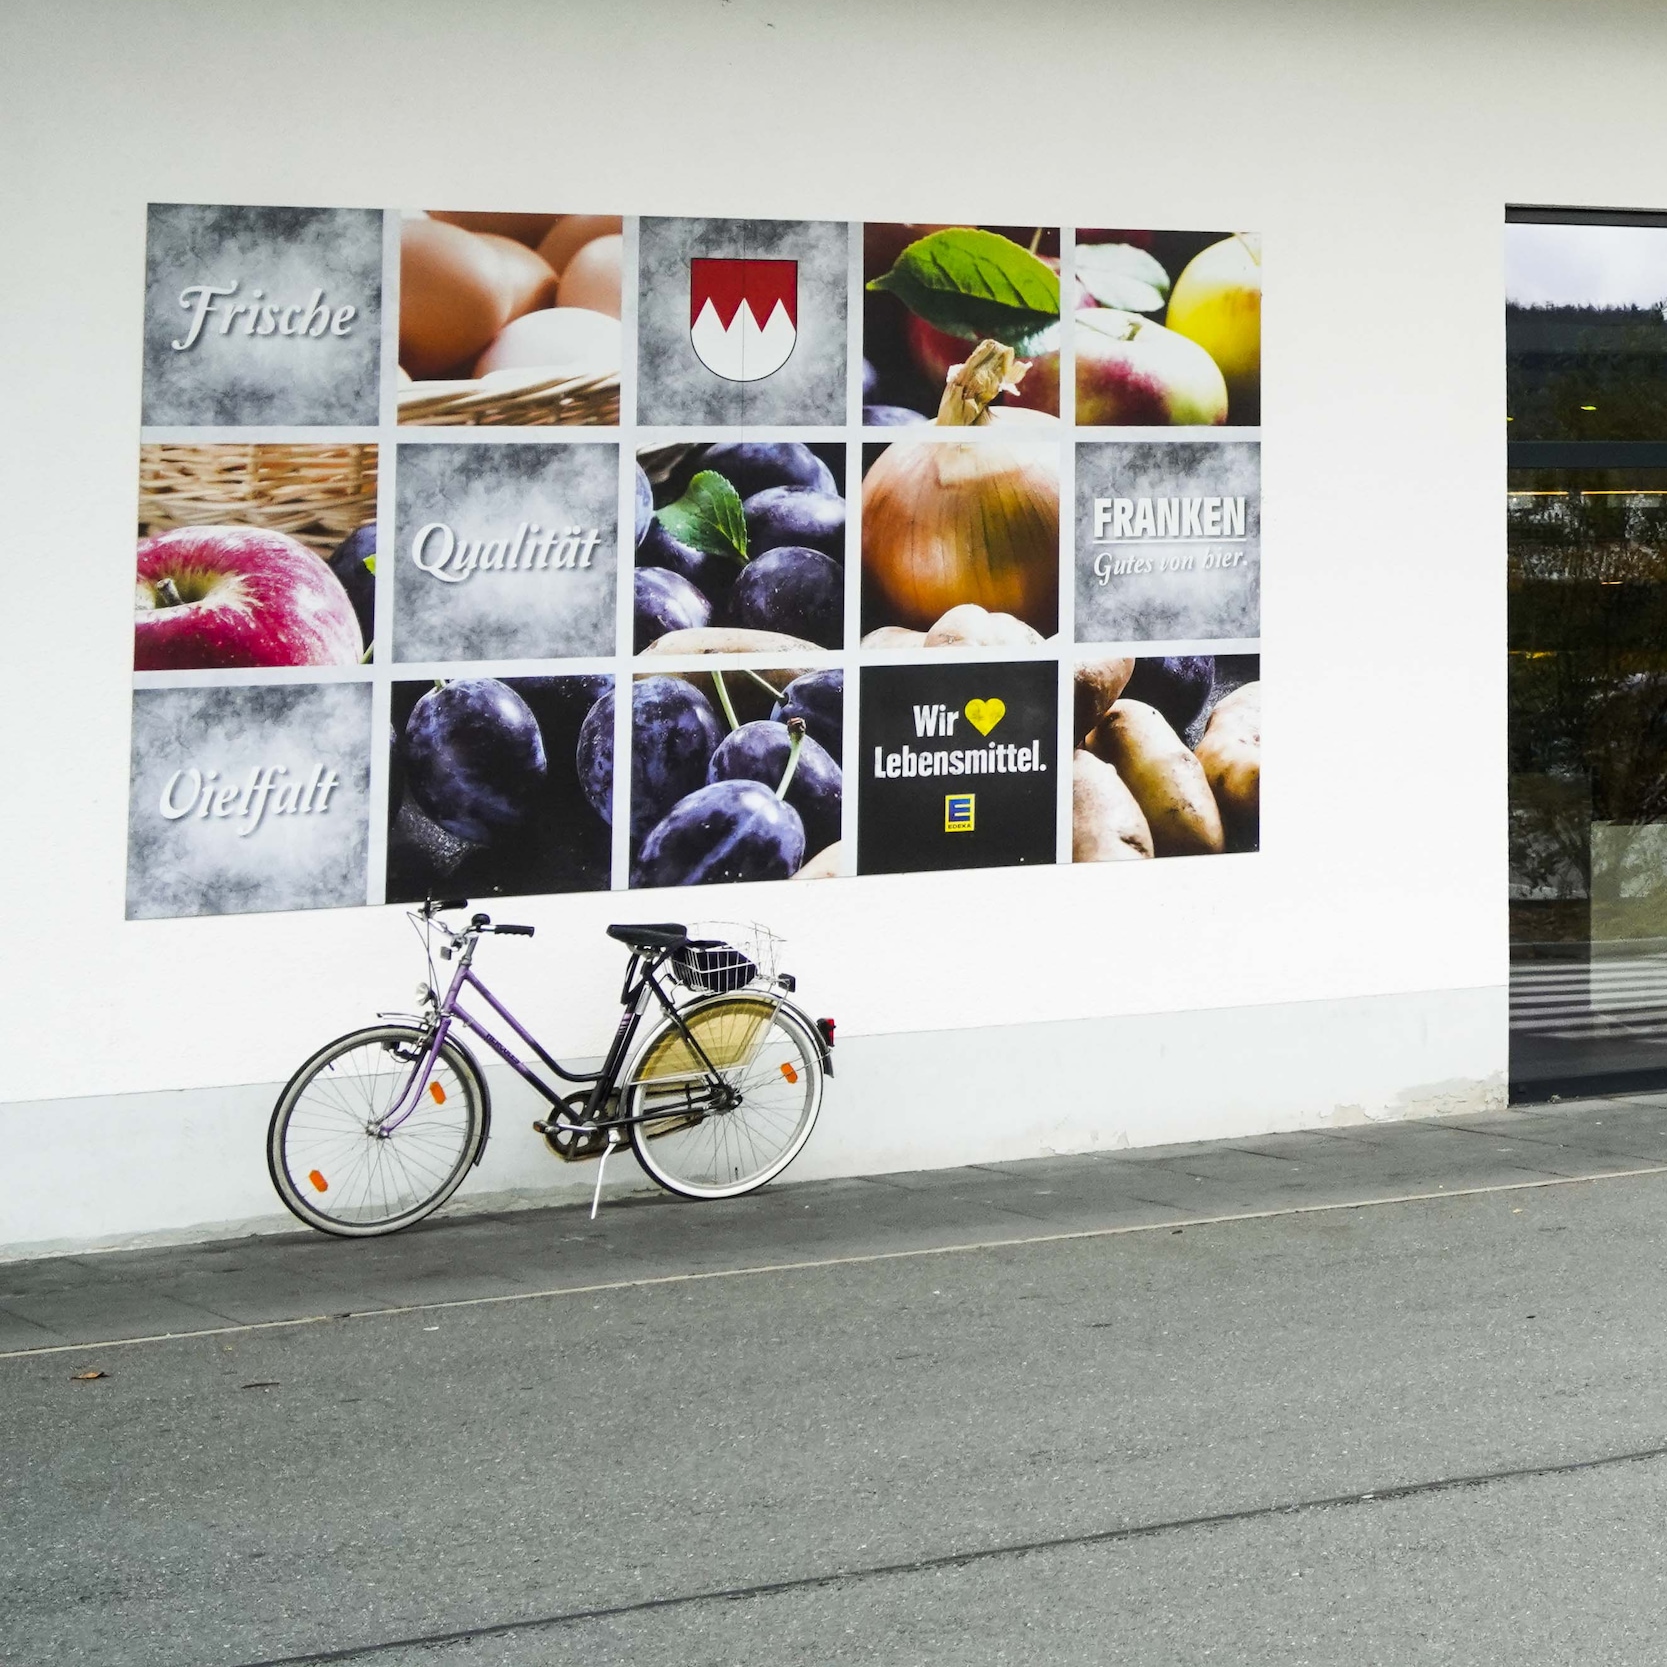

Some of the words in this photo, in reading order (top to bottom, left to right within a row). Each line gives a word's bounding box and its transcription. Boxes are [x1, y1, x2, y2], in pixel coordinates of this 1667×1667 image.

[172, 279, 355, 351] Frische
[1094, 496, 1246, 538] FRANKEN
[411, 522, 600, 583] Qualität
[1094, 552, 1154, 586] Gutes
[1160, 556, 1194, 572] von
[1202, 547, 1248, 569] hier.
[913, 704, 959, 737] Wir
[874, 739, 1047, 779] Lebensmittel.
[159, 762, 338, 836] Vielfalt
